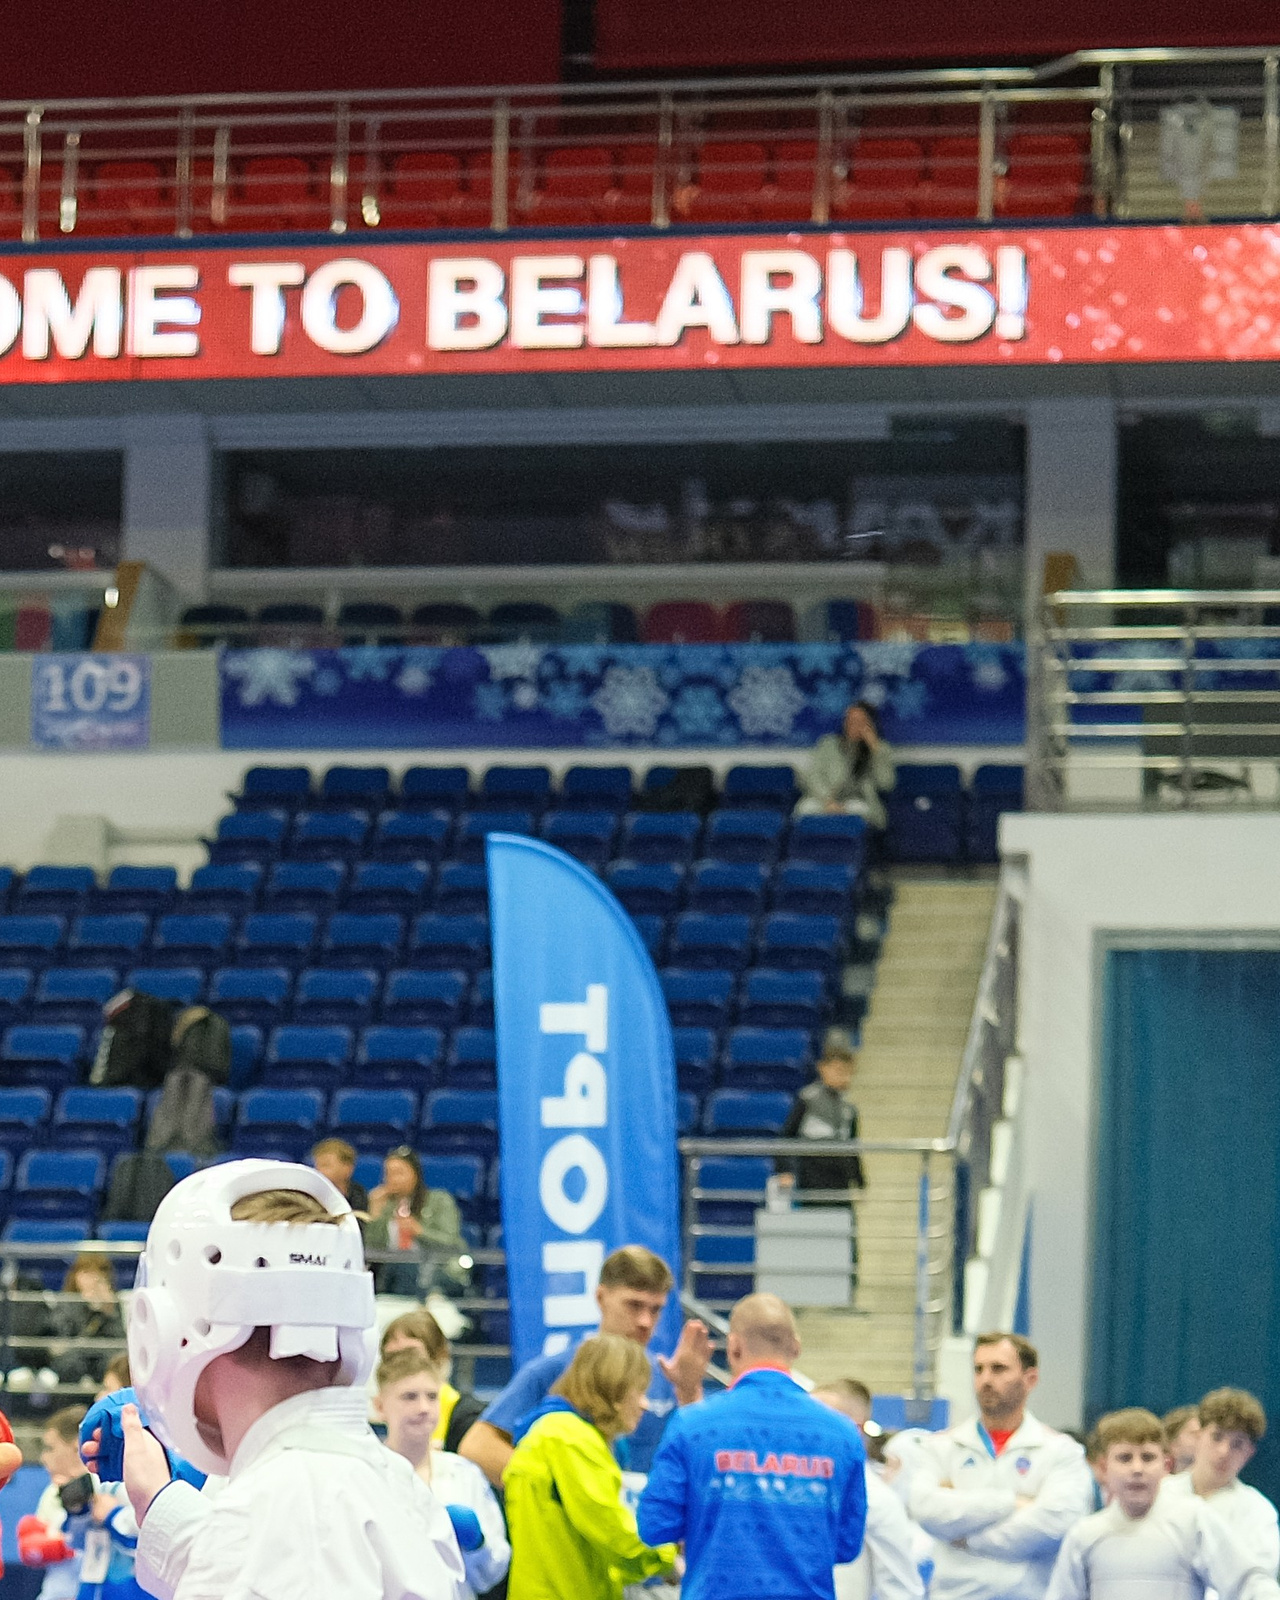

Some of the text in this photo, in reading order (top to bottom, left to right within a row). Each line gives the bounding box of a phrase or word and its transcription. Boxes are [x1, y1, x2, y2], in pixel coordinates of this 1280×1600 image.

[228, 259, 400, 355] TO
[427, 245, 1030, 352] BELARUS!
[42, 661, 143, 712] 109
